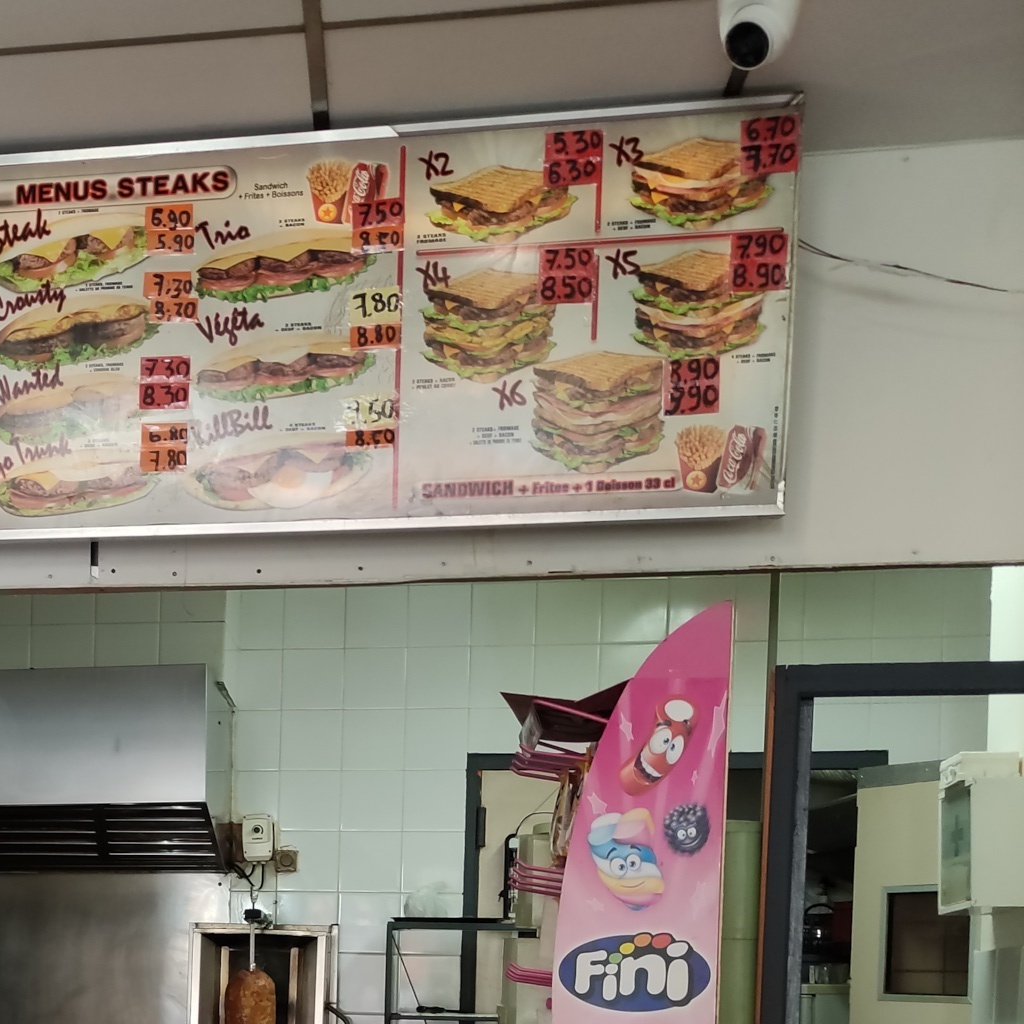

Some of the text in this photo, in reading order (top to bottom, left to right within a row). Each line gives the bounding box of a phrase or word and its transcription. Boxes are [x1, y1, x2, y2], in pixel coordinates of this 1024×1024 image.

[418, 150, 454, 180] X2
[609, 136, 644, 166] X3
[16, 170, 230, 205] MENUS STEAKS
[244, 190, 304, 200] Frites Boissons
[254, 182, 288, 190] Sandwich
[195, 220, 251, 250] Trio
[416, 260, 451, 289] X4
[605, 249, 641, 279] X5
[492, 380, 527, 410] X6
[422, 479, 514, 498] SANDWICH
[532, 482, 570, 494] Frites
[596, 479, 642, 492] Boisson
[645, 478, 660, 490] 33
[664, 477, 676, 488] cl
[574, 940, 689, 1002] Fini
